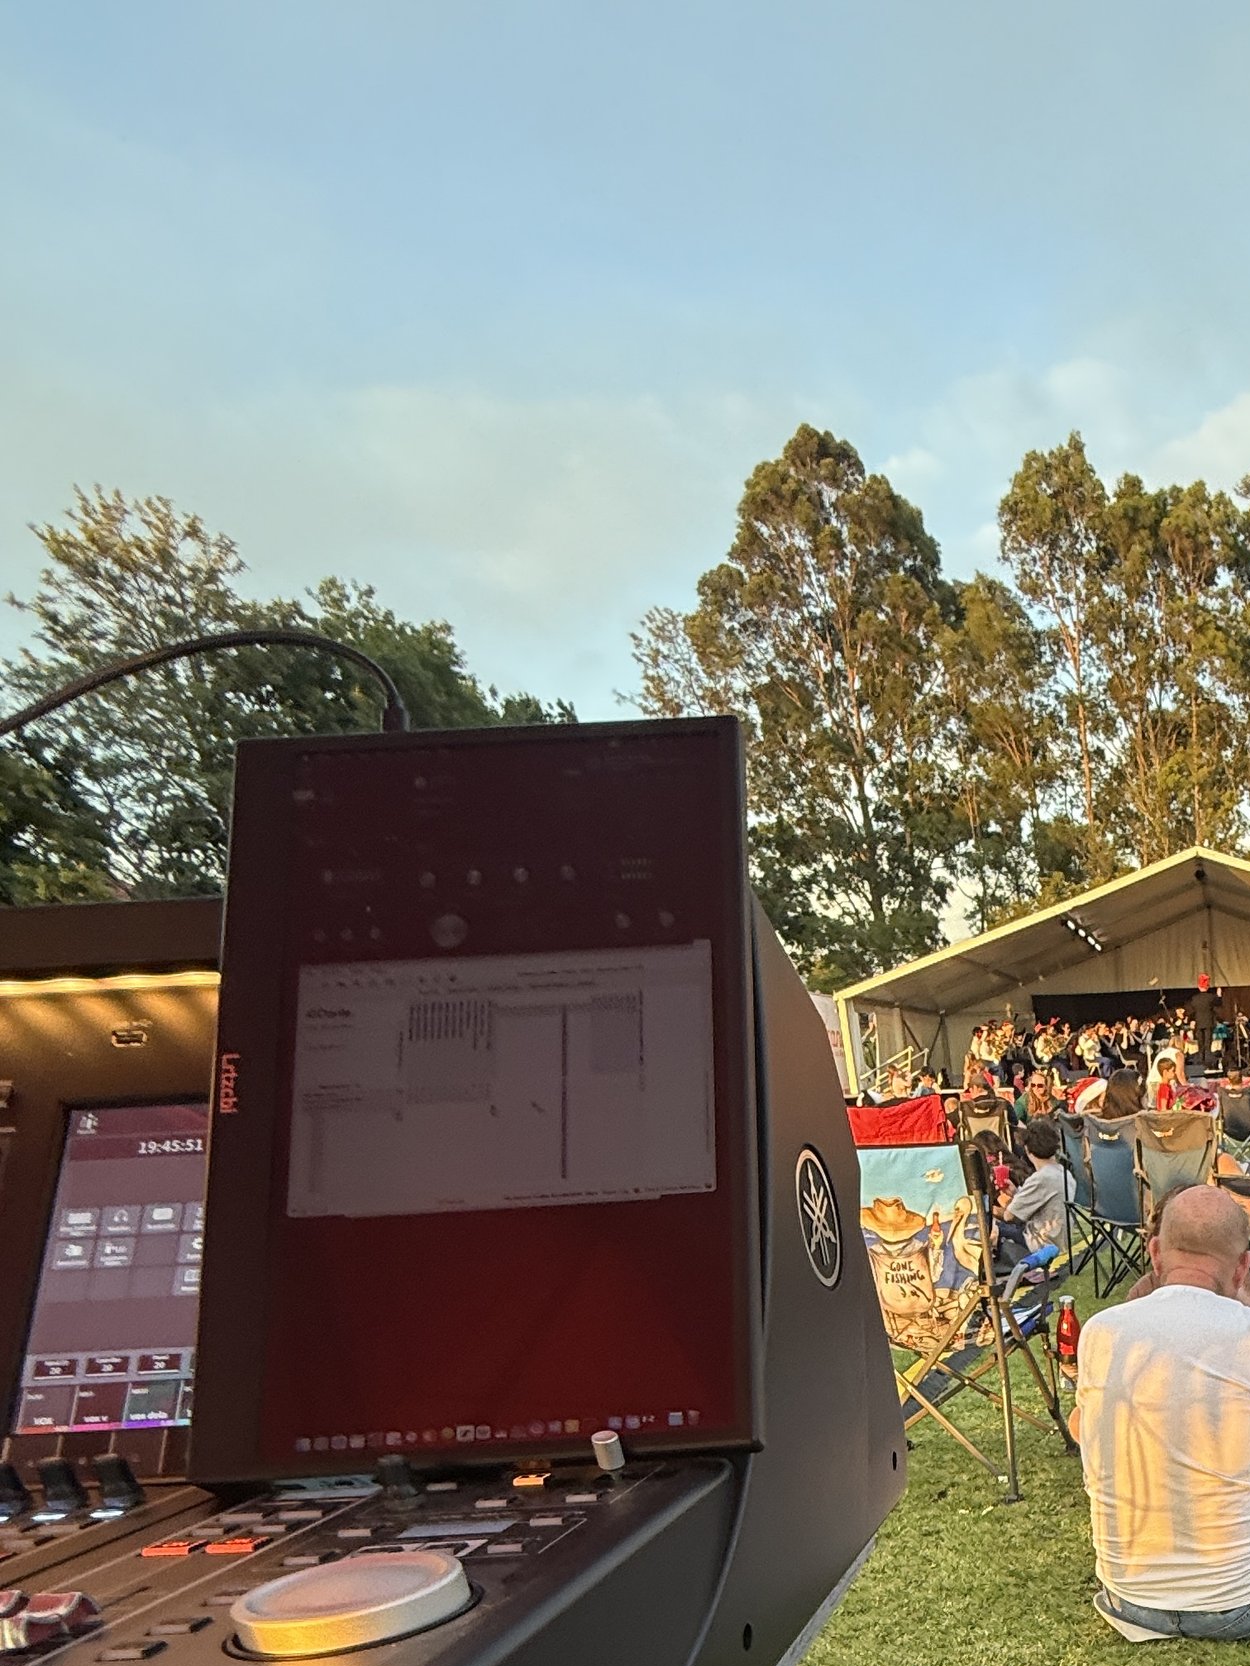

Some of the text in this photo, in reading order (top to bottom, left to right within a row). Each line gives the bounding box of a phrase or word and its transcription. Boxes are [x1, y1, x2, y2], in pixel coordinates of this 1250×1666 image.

[138, 1139, 203, 1154] 19:45:51
[890, 1261, 915, 1272] GONE
[885, 1270, 926, 1285] FISHING
